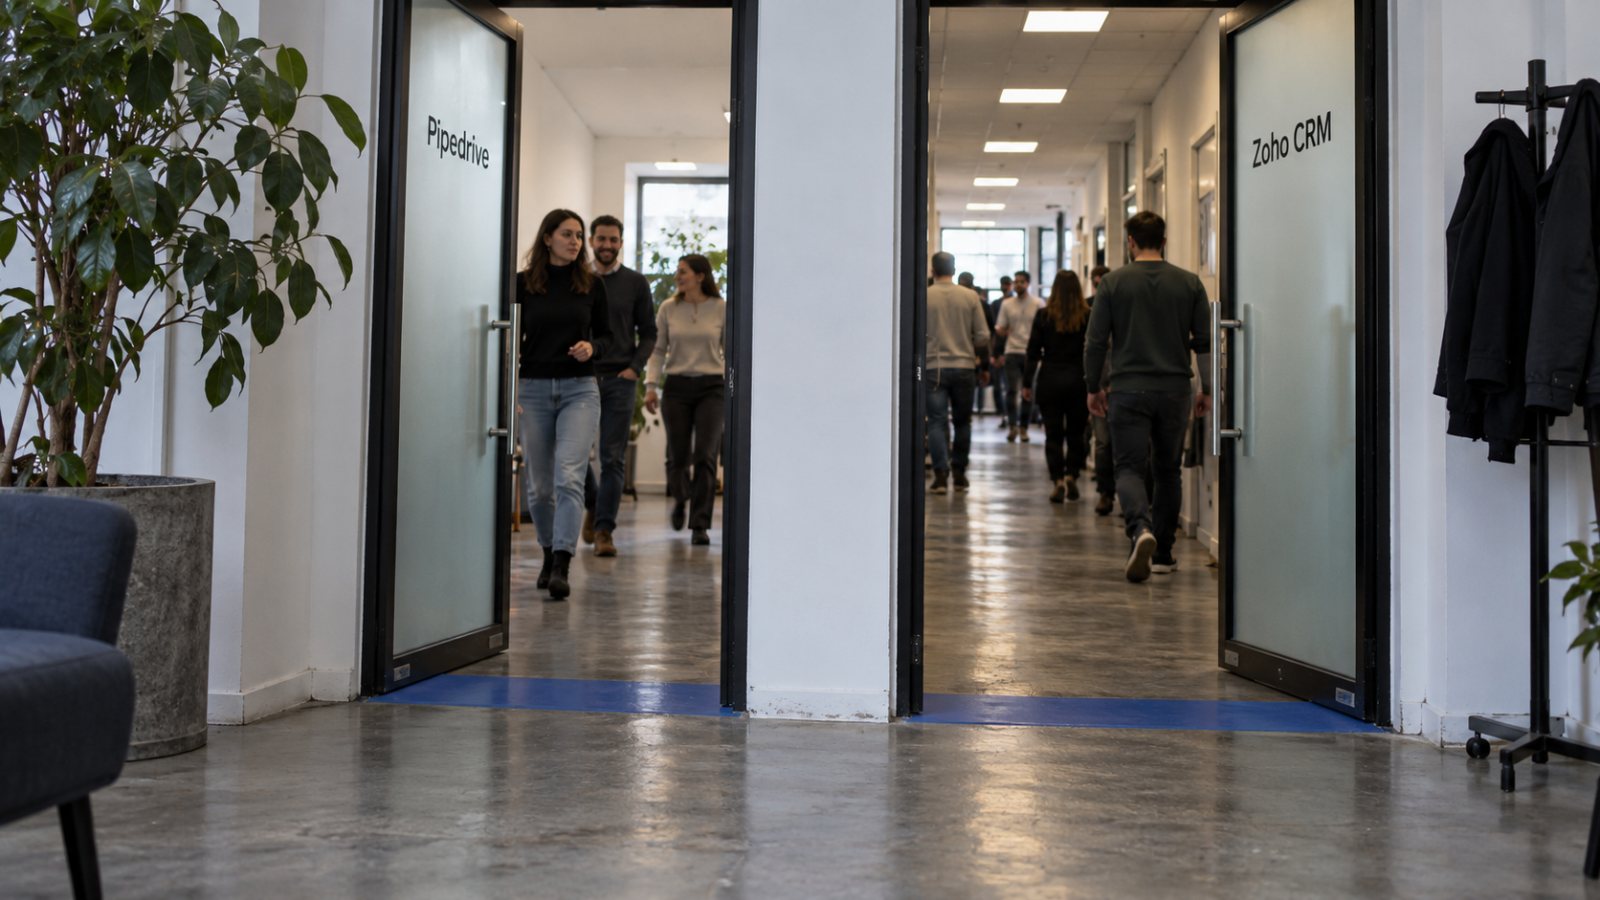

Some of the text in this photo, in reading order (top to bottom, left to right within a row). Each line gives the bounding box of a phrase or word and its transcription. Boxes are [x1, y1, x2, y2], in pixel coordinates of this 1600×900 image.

[427, 115, 489, 169] Pipedrive
[1252, 110, 1332, 169] Zoho CRM
